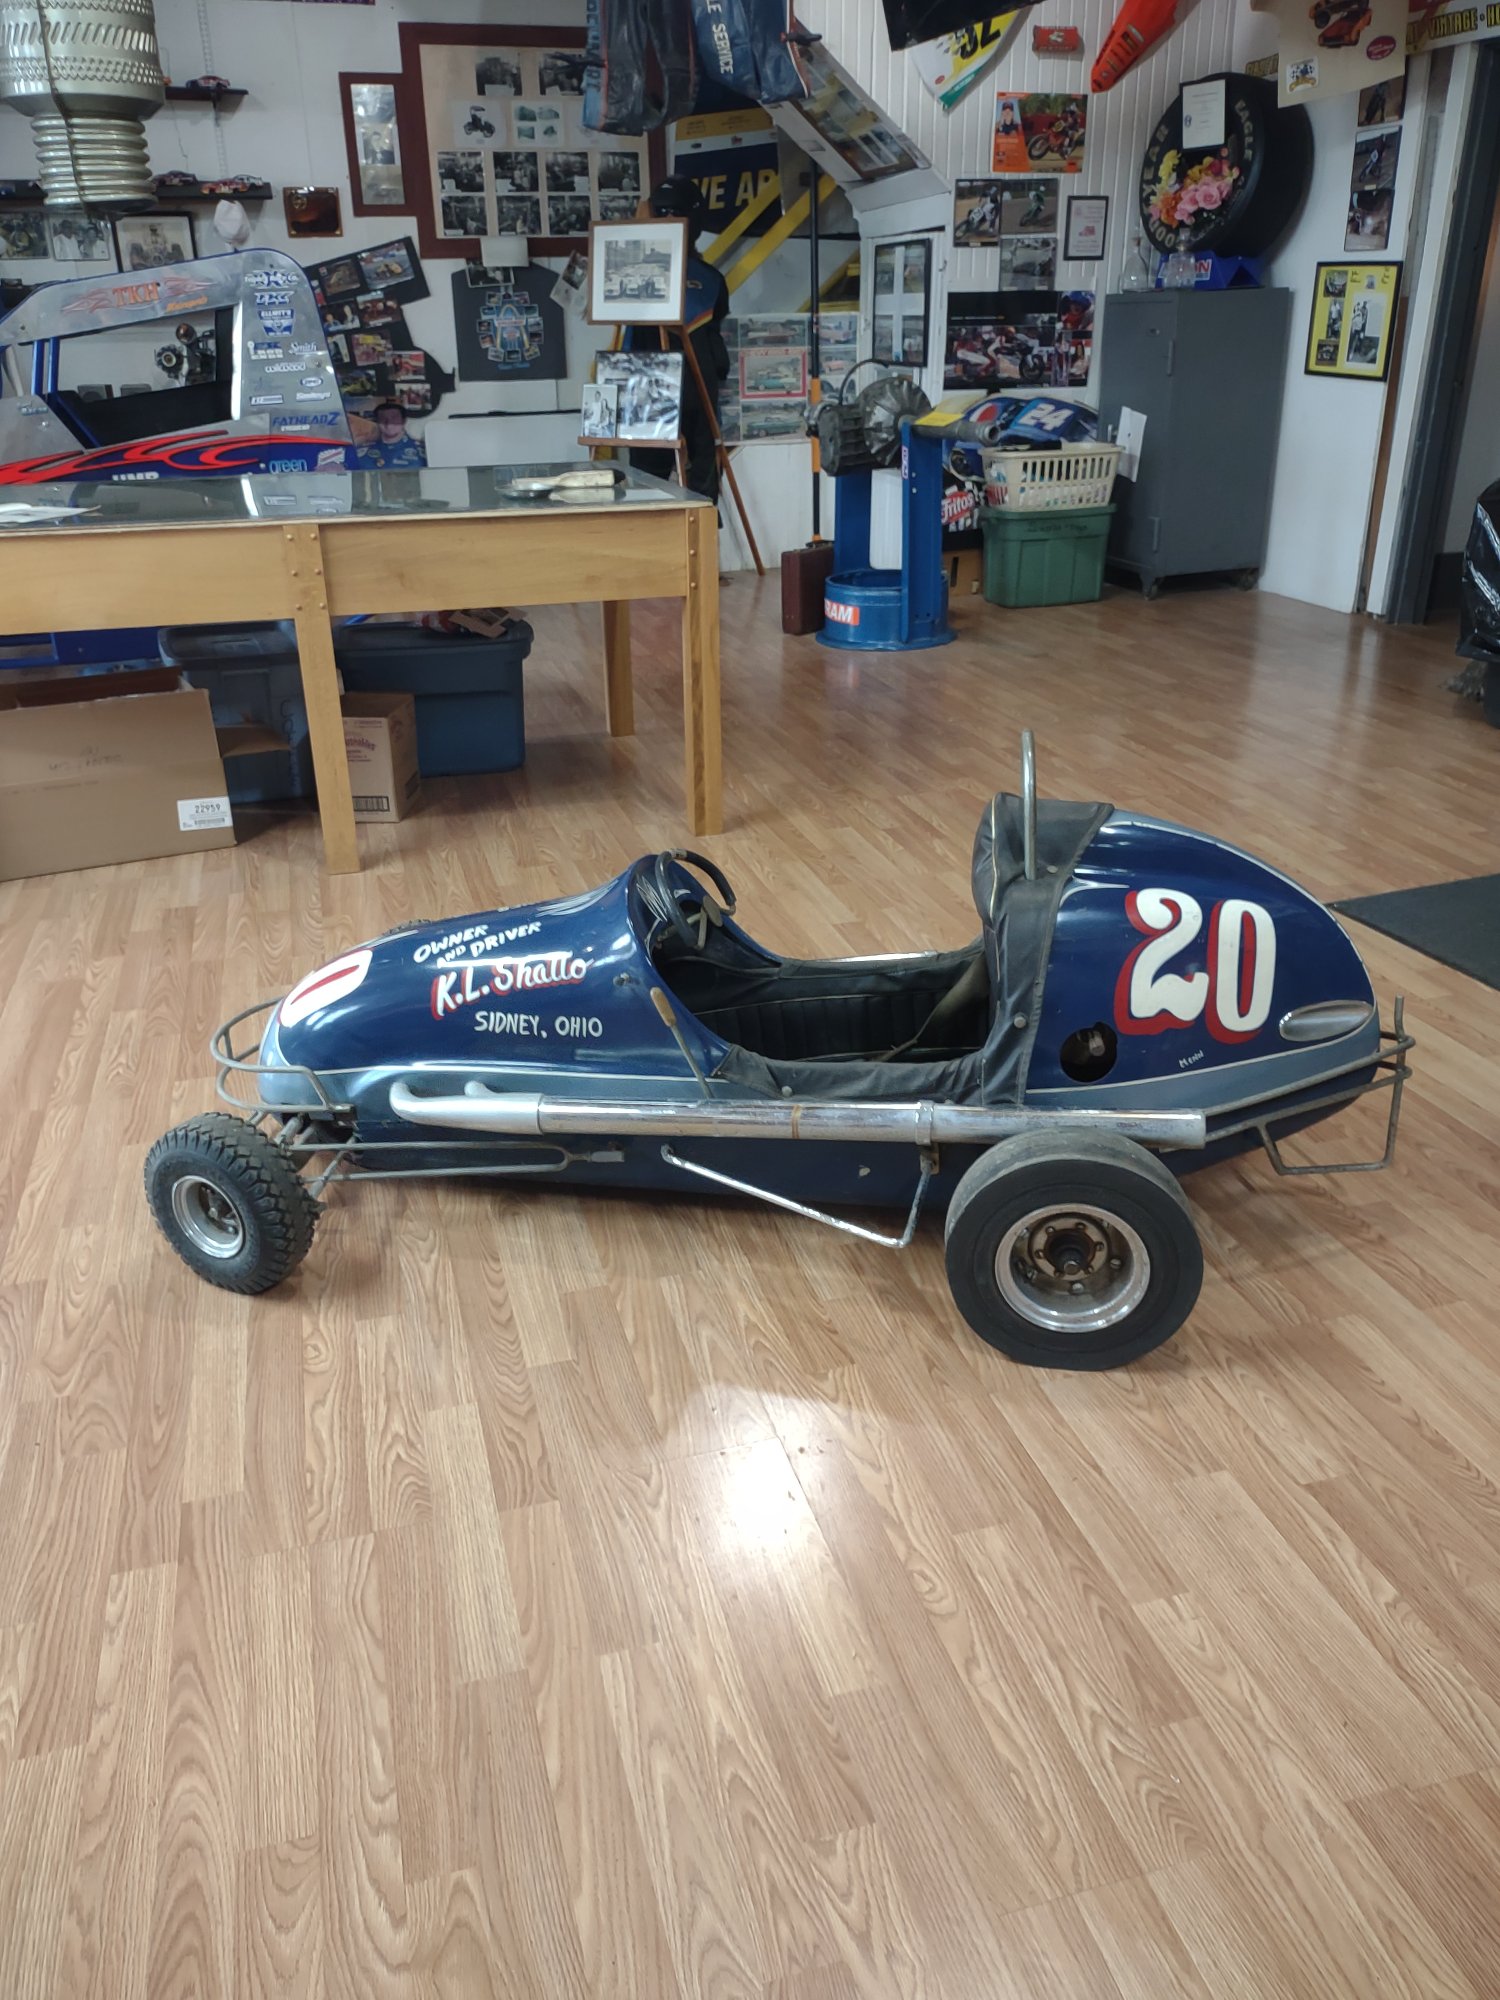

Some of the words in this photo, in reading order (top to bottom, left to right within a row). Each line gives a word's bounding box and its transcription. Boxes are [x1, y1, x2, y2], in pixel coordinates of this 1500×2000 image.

[1429, 8, 1478, 40] VINTAGE
[712, 24, 734, 74] SERVICE
[1234, 99, 1254, 161] EAGLE
[288, 341, 317, 354] Smith
[1018, 403, 1075, 430] 24
[413, 924, 489, 963] OWNER
[437, 945, 467, 968] AND
[469, 921, 542, 958] DRIVER
[1117, 888, 1276, 1040] 20
[554, 1015, 603, 1039] OHIO
